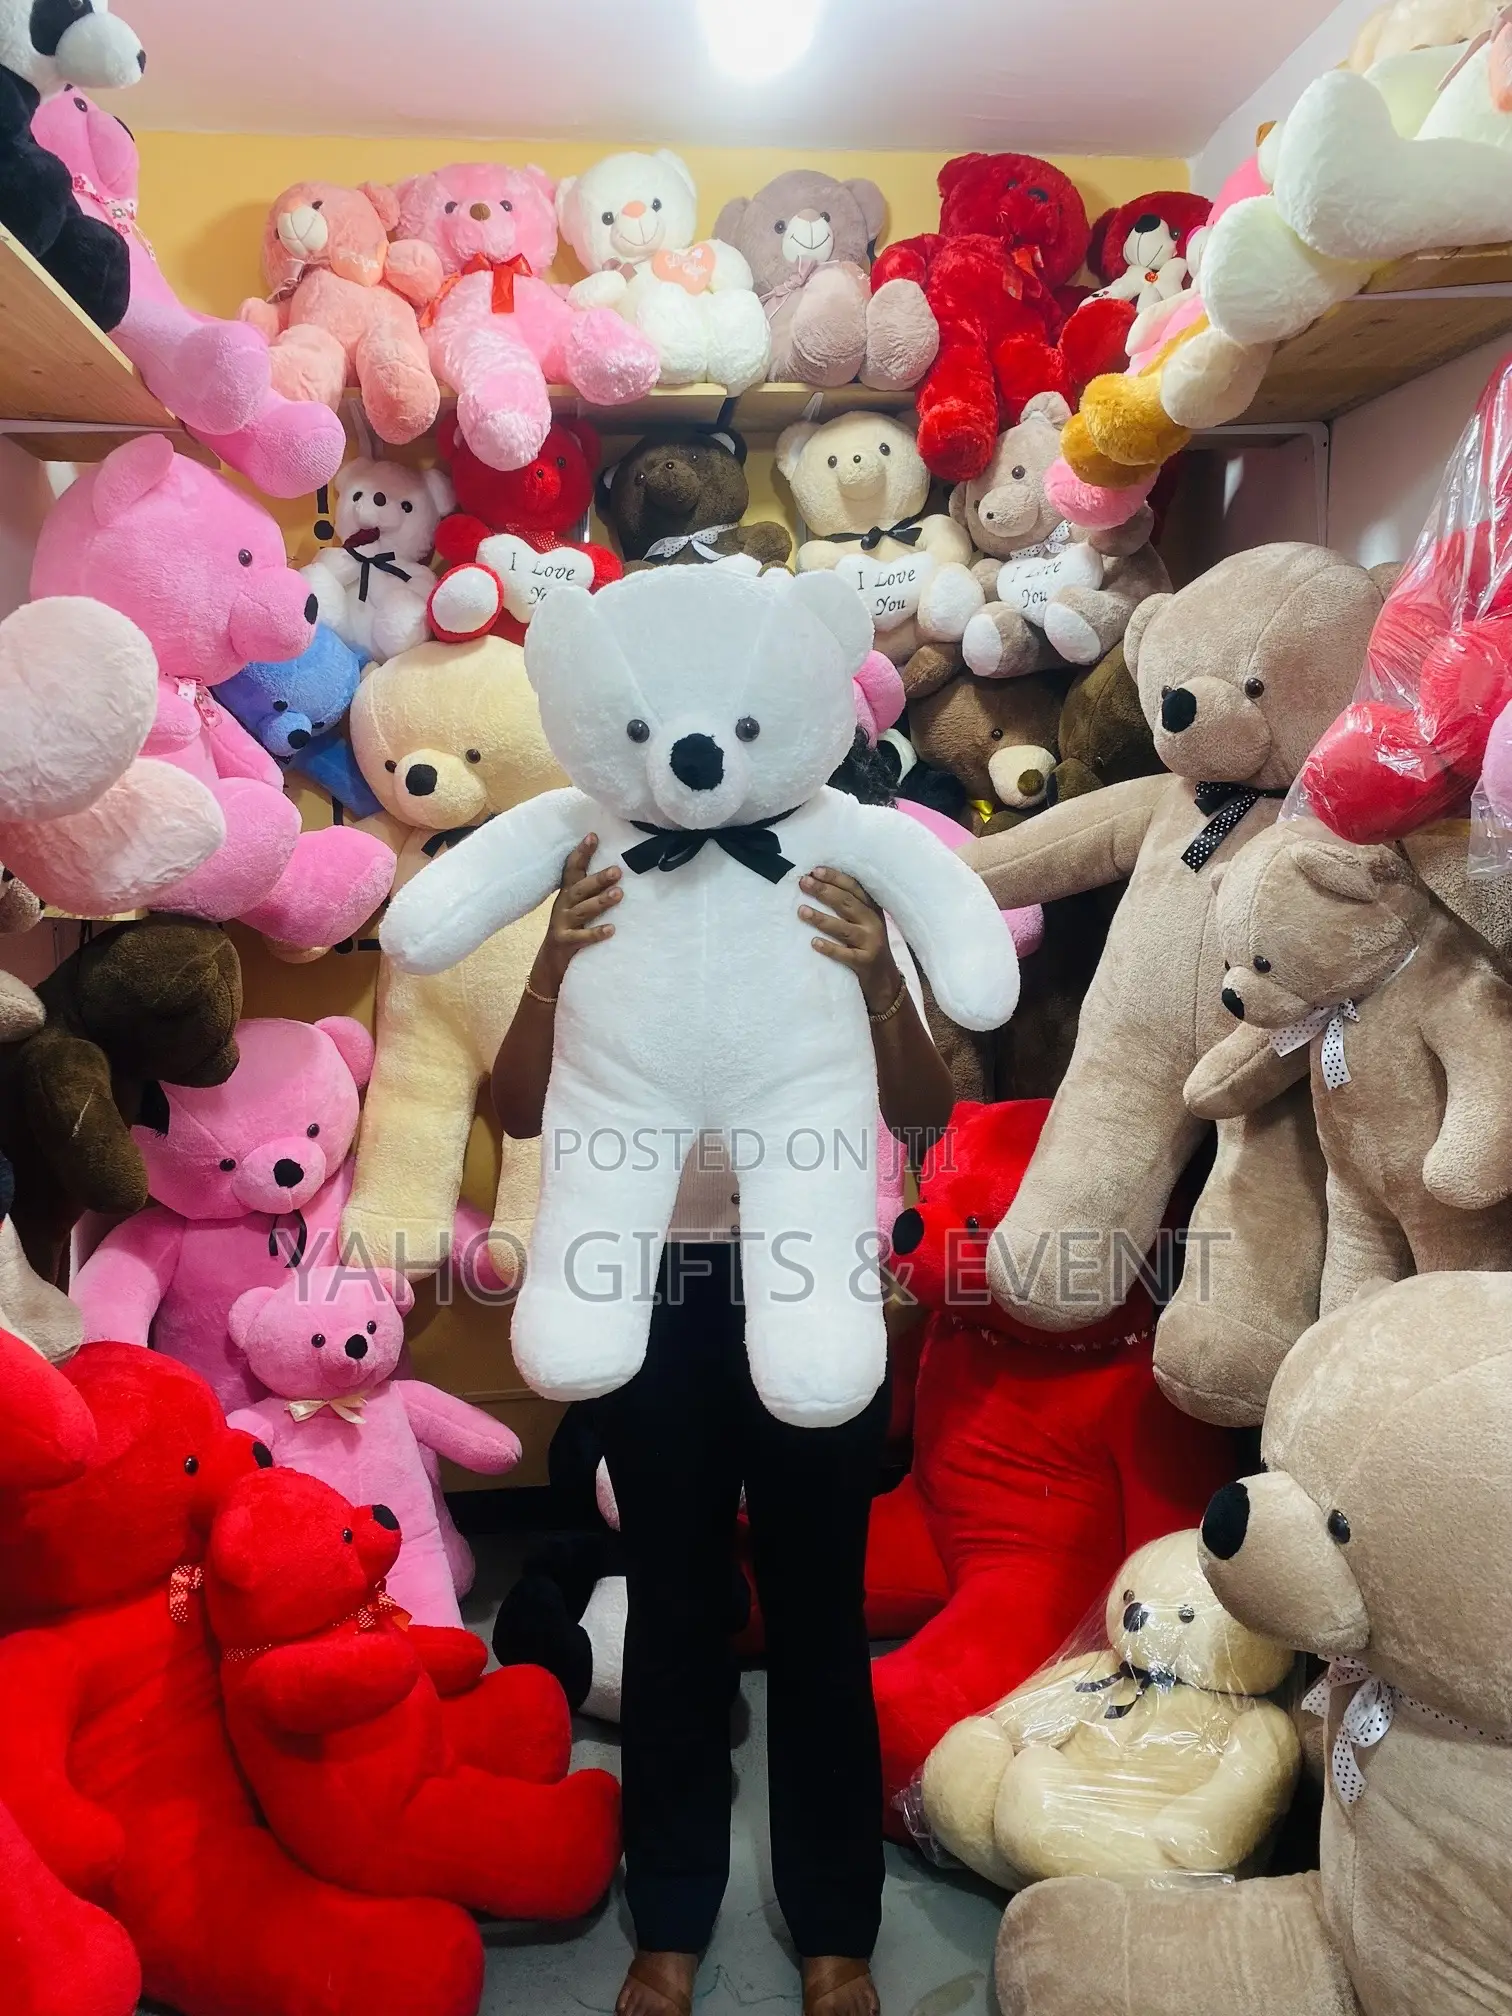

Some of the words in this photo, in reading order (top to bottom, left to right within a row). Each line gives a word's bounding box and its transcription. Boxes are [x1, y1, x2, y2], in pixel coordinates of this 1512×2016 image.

[508, 551, 517, 572] I
[531, 560, 576, 581] Love
[857, 571, 865, 591] I
[874, 568, 917, 588] Love
[875, 596, 906, 616] You
